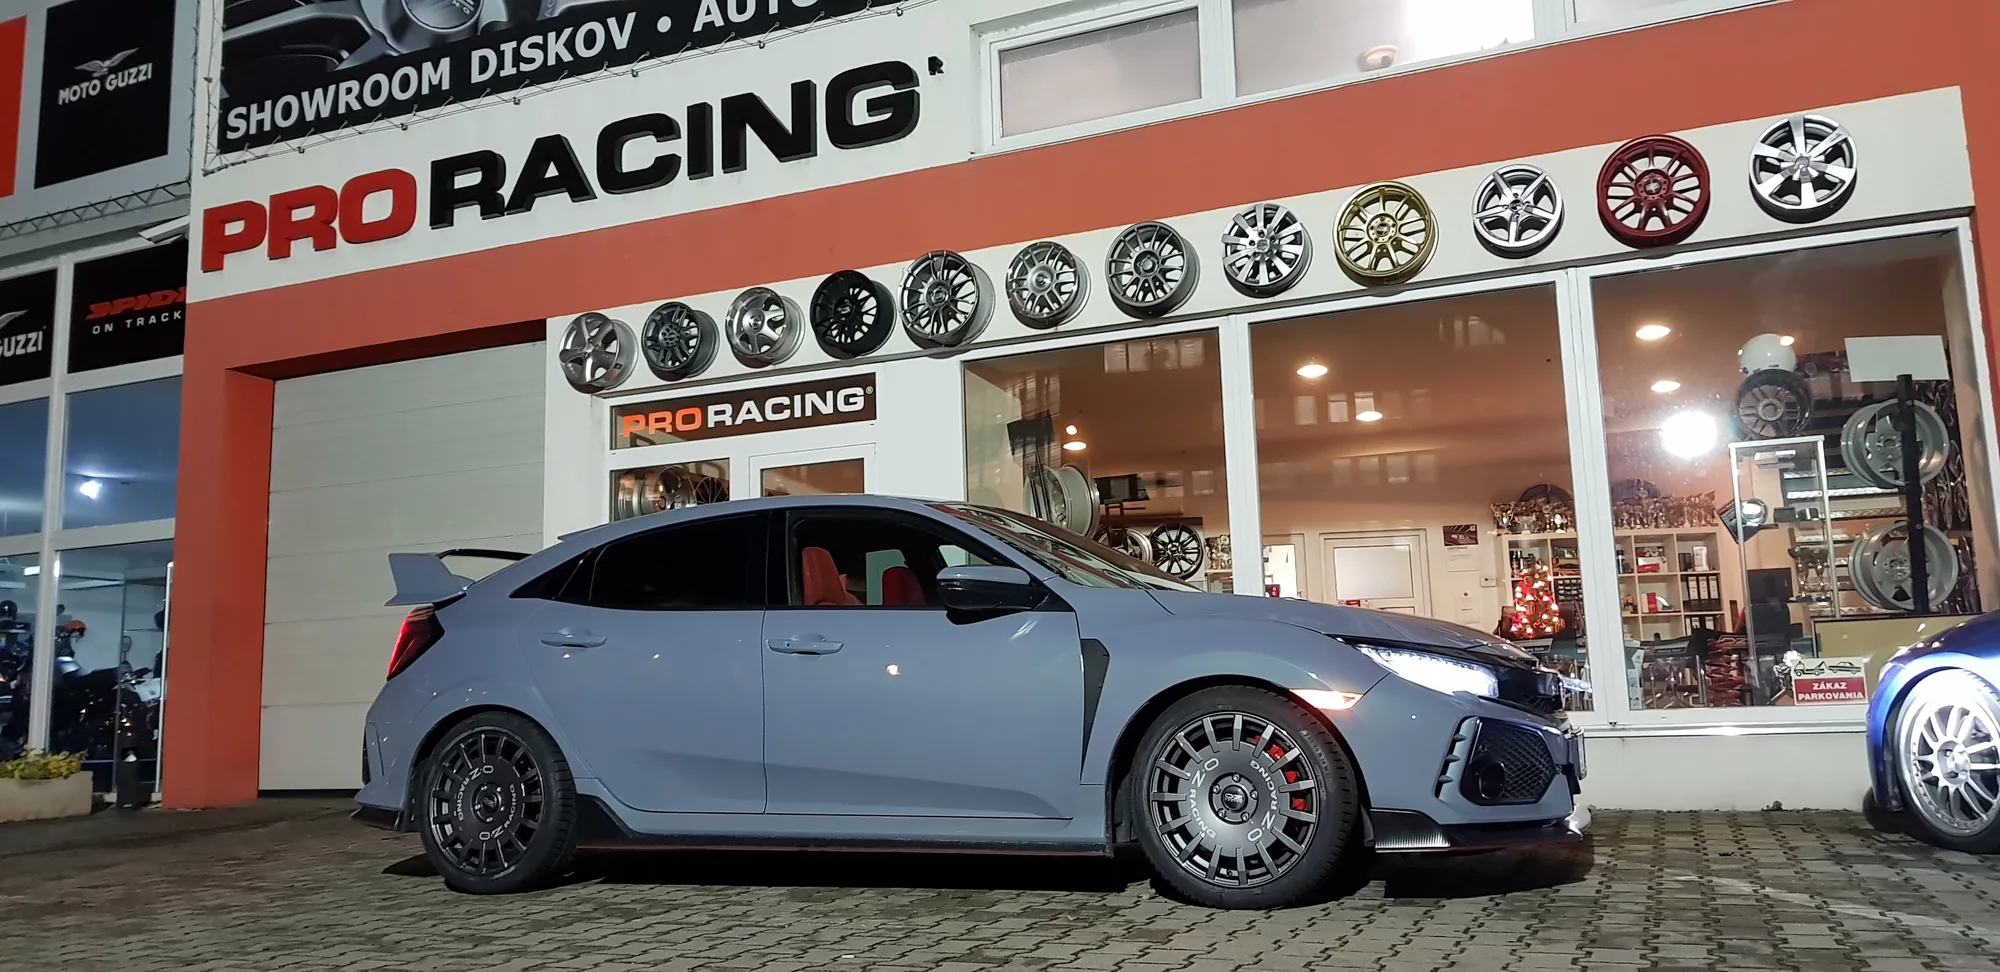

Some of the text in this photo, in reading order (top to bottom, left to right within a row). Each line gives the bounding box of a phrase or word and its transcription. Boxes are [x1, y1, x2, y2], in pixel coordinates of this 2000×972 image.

[57, 63, 153, 105] MOTO GUZZI
[226, 57, 450, 140] SHOWROOM
[471, 12, 636, 85] DISKOV
[201, 60, 921, 273] PRO RACING
[92, 310, 182, 334] ON TRACK
[0, 331, 43, 357] UZZI
[622, 407, 702, 438] PRO
[1798, 691, 1865, 701] PARKOVANIA
[1812, 681, 1847, 690] ZÁKAZ
[456, 777, 470, 821] RACING
[504, 784, 516, 828] RACING
[1250, 760, 1278, 810] RACING
[1189, 789, 1216, 838] RACING
